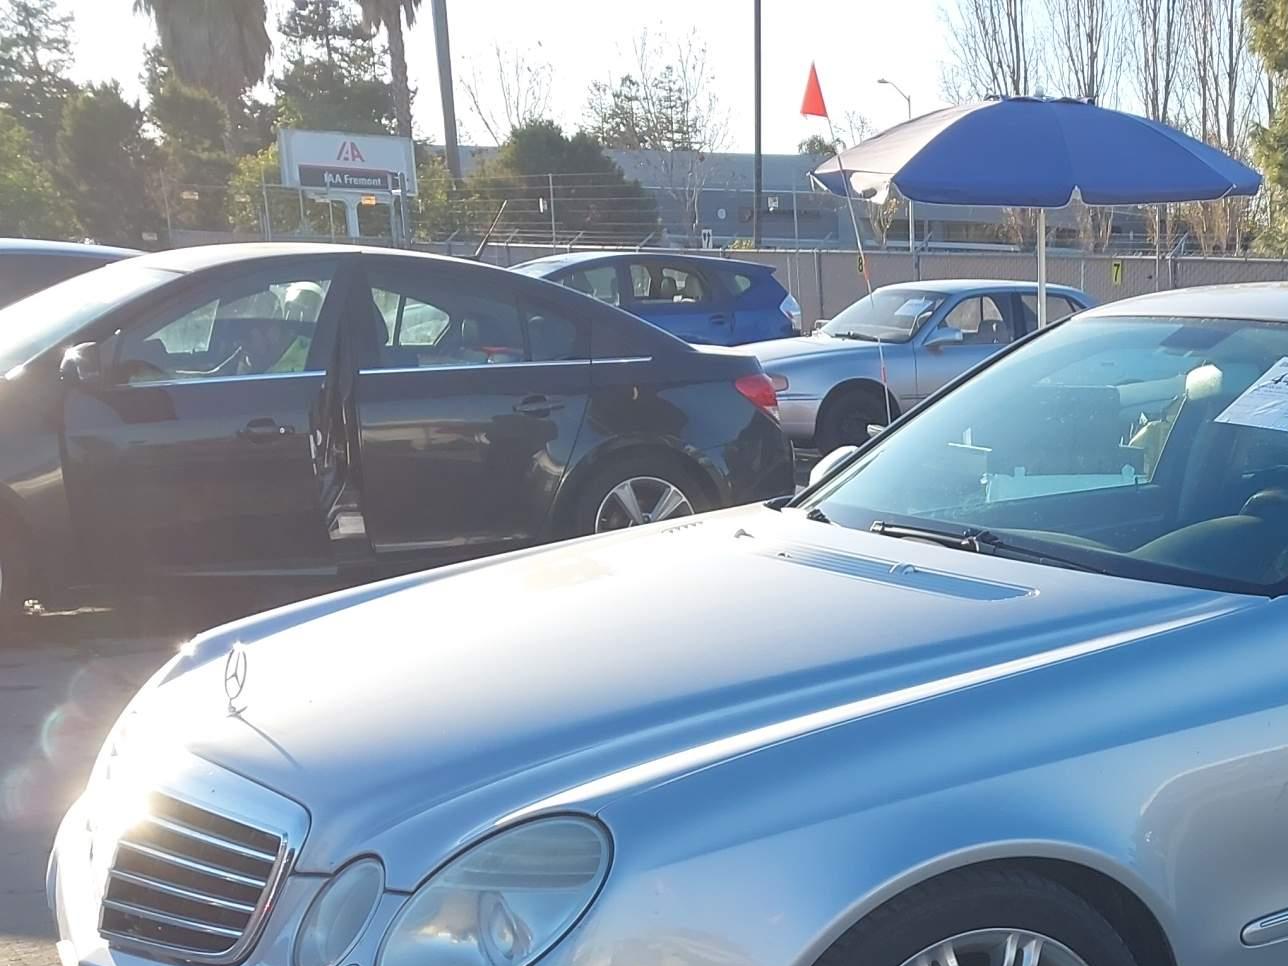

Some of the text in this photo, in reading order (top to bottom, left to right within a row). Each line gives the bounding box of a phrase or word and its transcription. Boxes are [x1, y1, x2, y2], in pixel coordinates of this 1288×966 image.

[344, 175, 381, 185] Fremont
[858, 256, 864, 273] 8
[1113, 263, 1121, 282] 7
